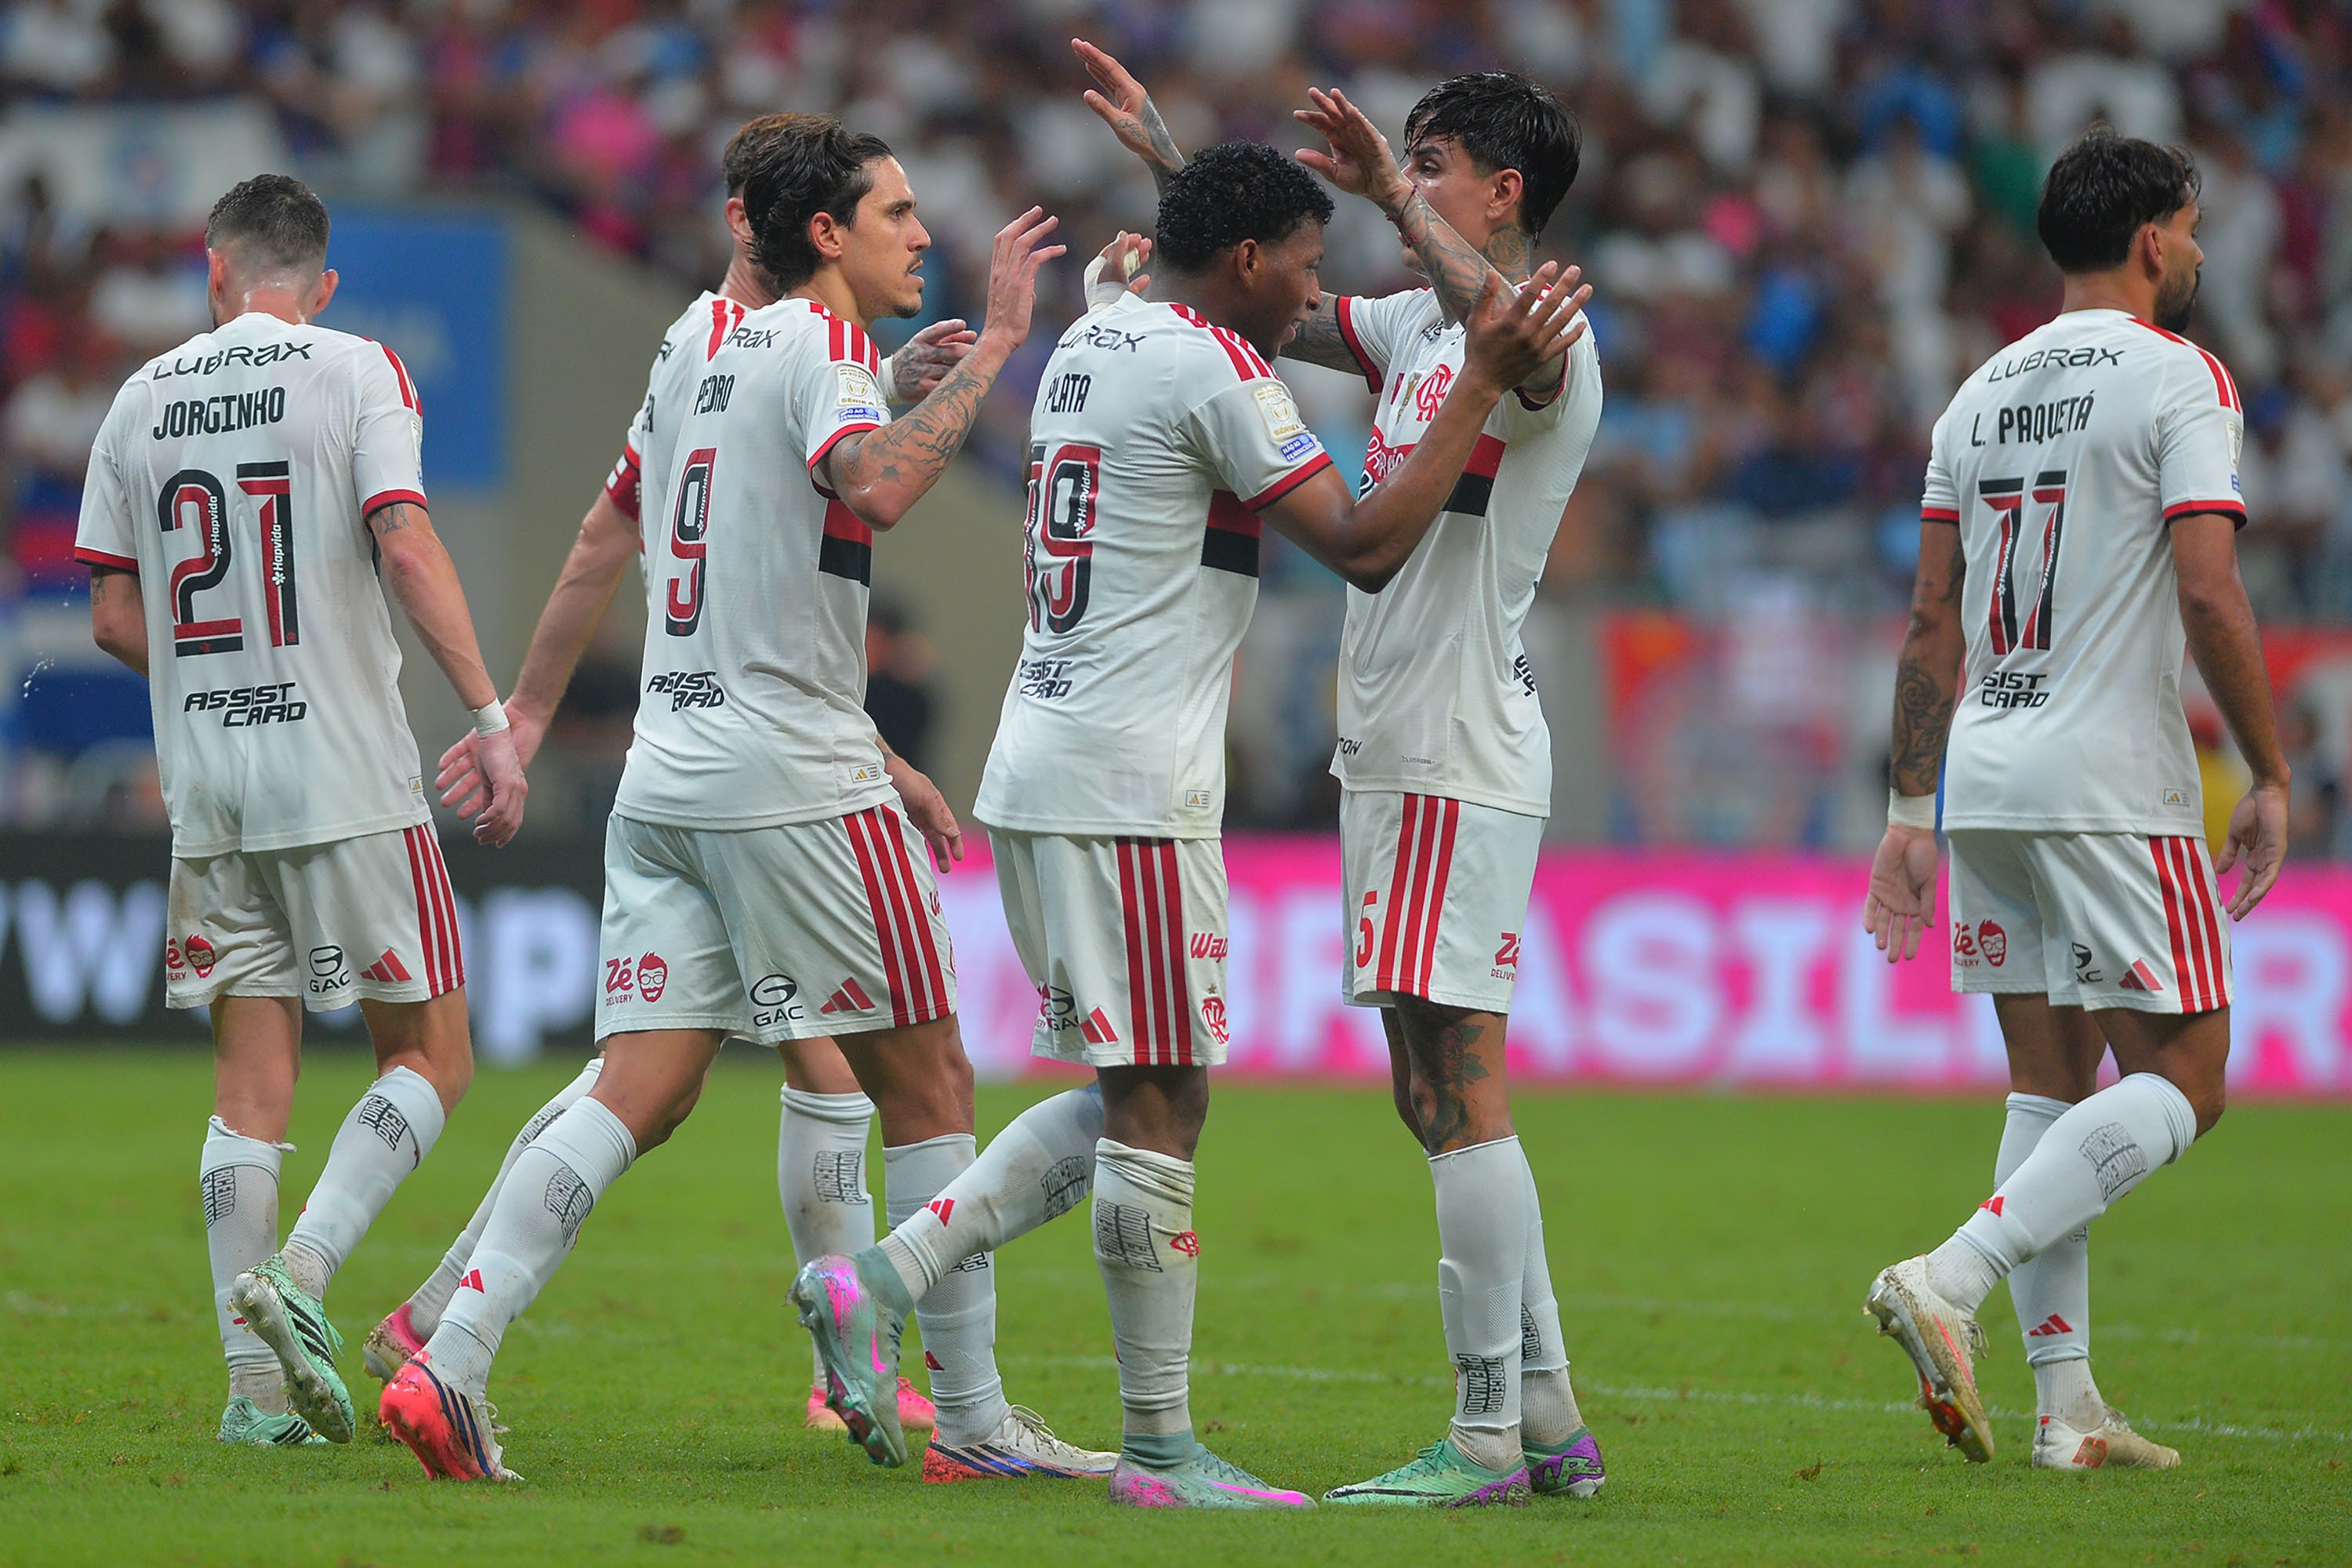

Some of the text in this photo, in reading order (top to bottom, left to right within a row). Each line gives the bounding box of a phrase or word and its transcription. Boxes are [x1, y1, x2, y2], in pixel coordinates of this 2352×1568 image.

[723, 328, 781, 349] RAX
[153, 387, 285, 440] JORGINHO
[694, 374, 735, 416] PEDRO
[1043, 373, 1092, 413] PLATA
[1971, 390, 2095, 447] L. PAQUETÁ
[1077, 468, 1091, 517] Hapvida
[208, 495, 220, 543] Hapvida
[1024, 445, 1101, 633] 19
[158, 460, 300, 657] 21
[270, 524, 285, 571] Hapvida
[665, 448, 717, 637] 9
[183, 683, 296, 712] ASSIST
[671, 688, 725, 712] ARD
[1981, 671, 2048, 689] SIST
[1982, 690, 2049, 708] CARD
[223, 702, 307, 727] CARD
[1356, 891, 1377, 968] 5
[310, 969, 351, 993] GAC
[606, 956, 634, 994] Zé
[1490, 967, 1515, 982] DELIVE
[2076, 969, 2103, 984] AC
[606, 994, 633, 1007] DELIVERY
[753, 1005, 804, 1028] GAC
[214, 1167, 235, 1220] RCEDOR
[838, 1150, 868, 1205] PREMIADO
[1457, 1353, 1486, 1414] PREMIADO
[1484, 1356, 1506, 1413] TORCEDOR
